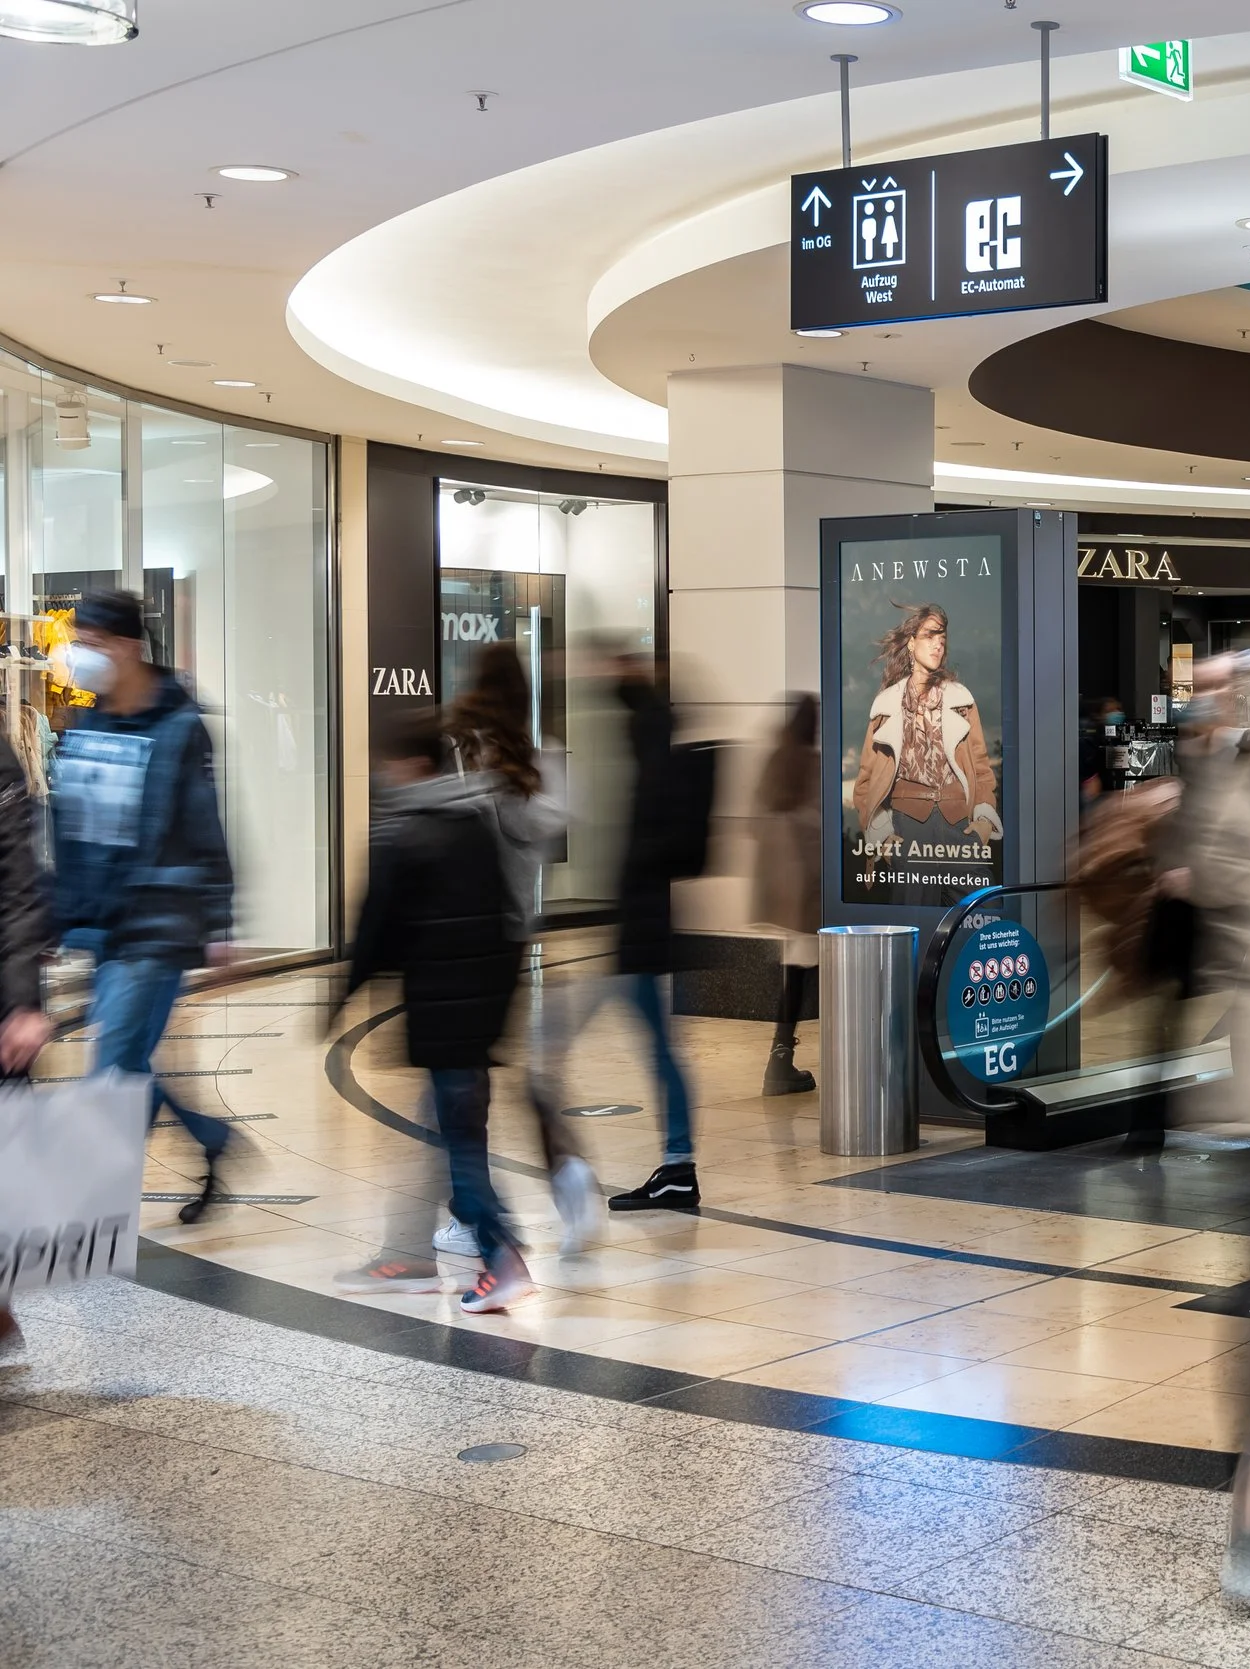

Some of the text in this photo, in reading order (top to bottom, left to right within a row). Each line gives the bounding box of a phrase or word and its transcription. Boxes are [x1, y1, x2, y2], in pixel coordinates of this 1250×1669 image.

[801, 235, 832, 250] im OG
[861, 274, 898, 289] Aufzug
[961, 276, 1025, 295] EC-Automat
[866, 289, 893, 304] West
[1078, 548, 1181, 581] ZARA
[372, 667, 433, 696] ZARA
[852, 839, 992, 860] Jetzt Anewsta
[855, 871, 990, 886] auf SHEIN entdecken
[980, 930, 1019, 941] Ihre Sicherheit
[983, 1041, 1018, 1076] EG
